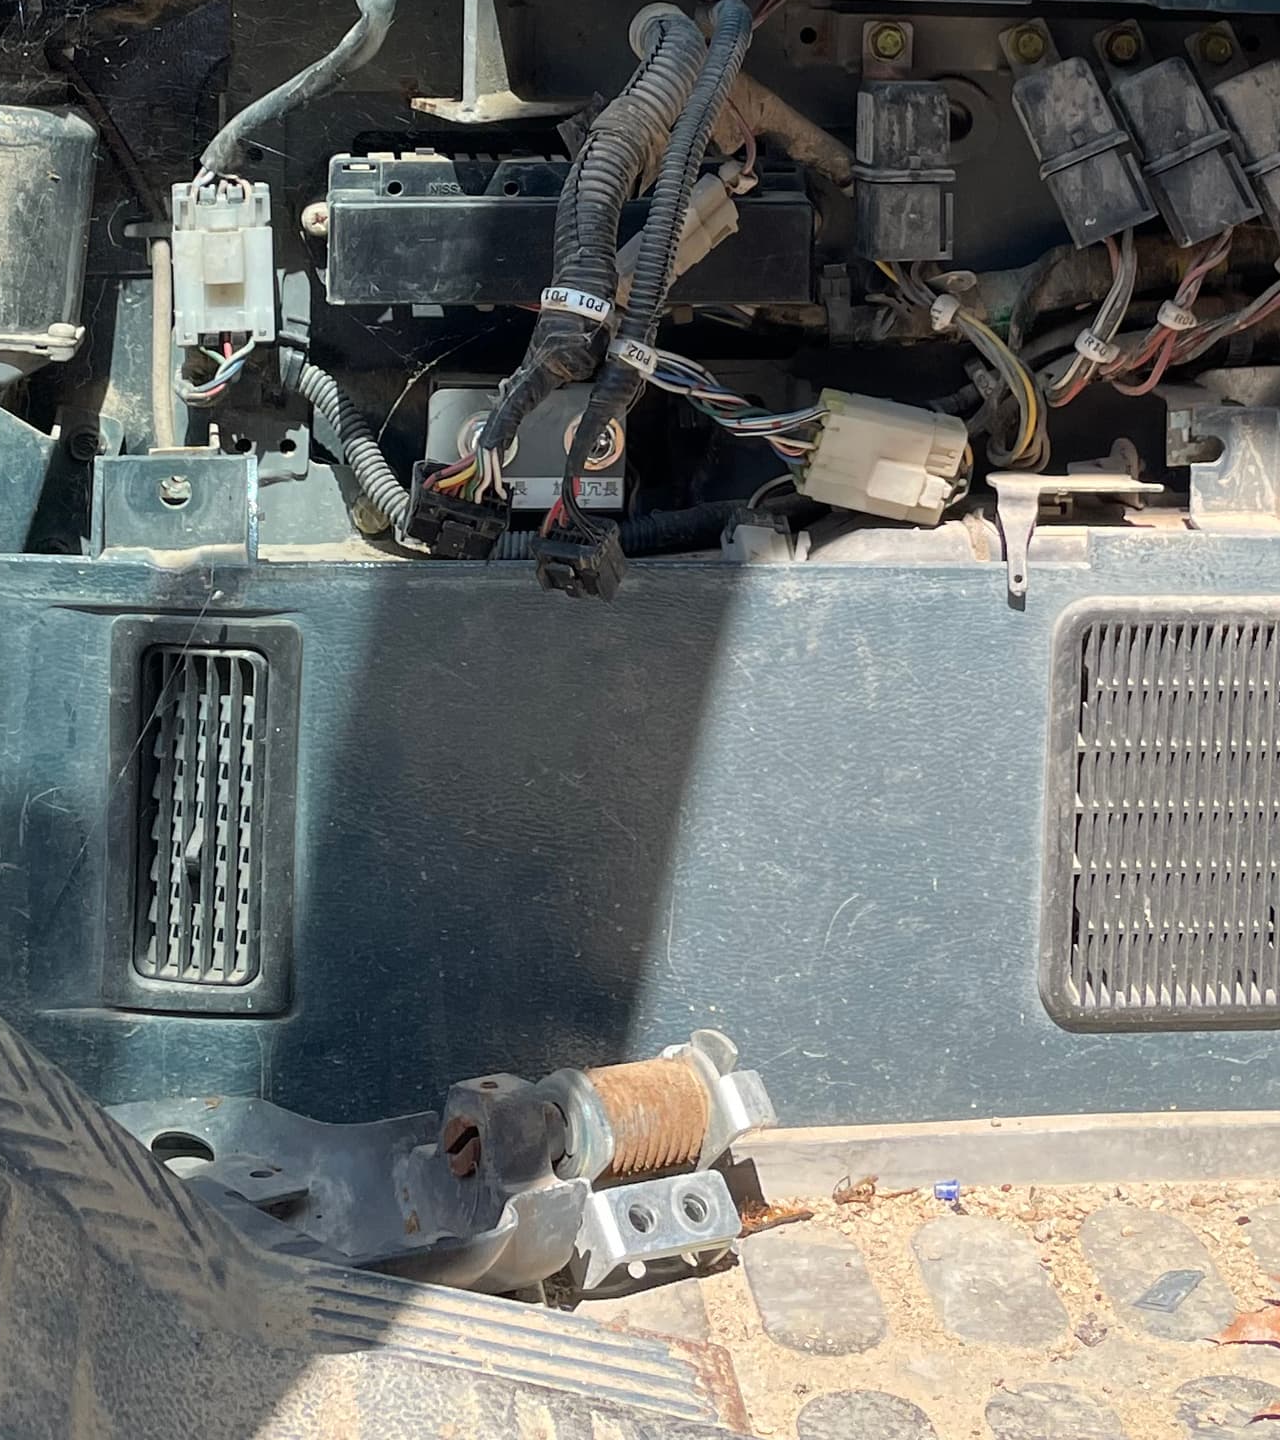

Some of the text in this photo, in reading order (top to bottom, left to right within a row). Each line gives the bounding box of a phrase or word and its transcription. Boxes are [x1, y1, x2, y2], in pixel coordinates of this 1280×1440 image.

[544, 288, 605, 312] P01 P01
[627, 343, 653, 366] P02
